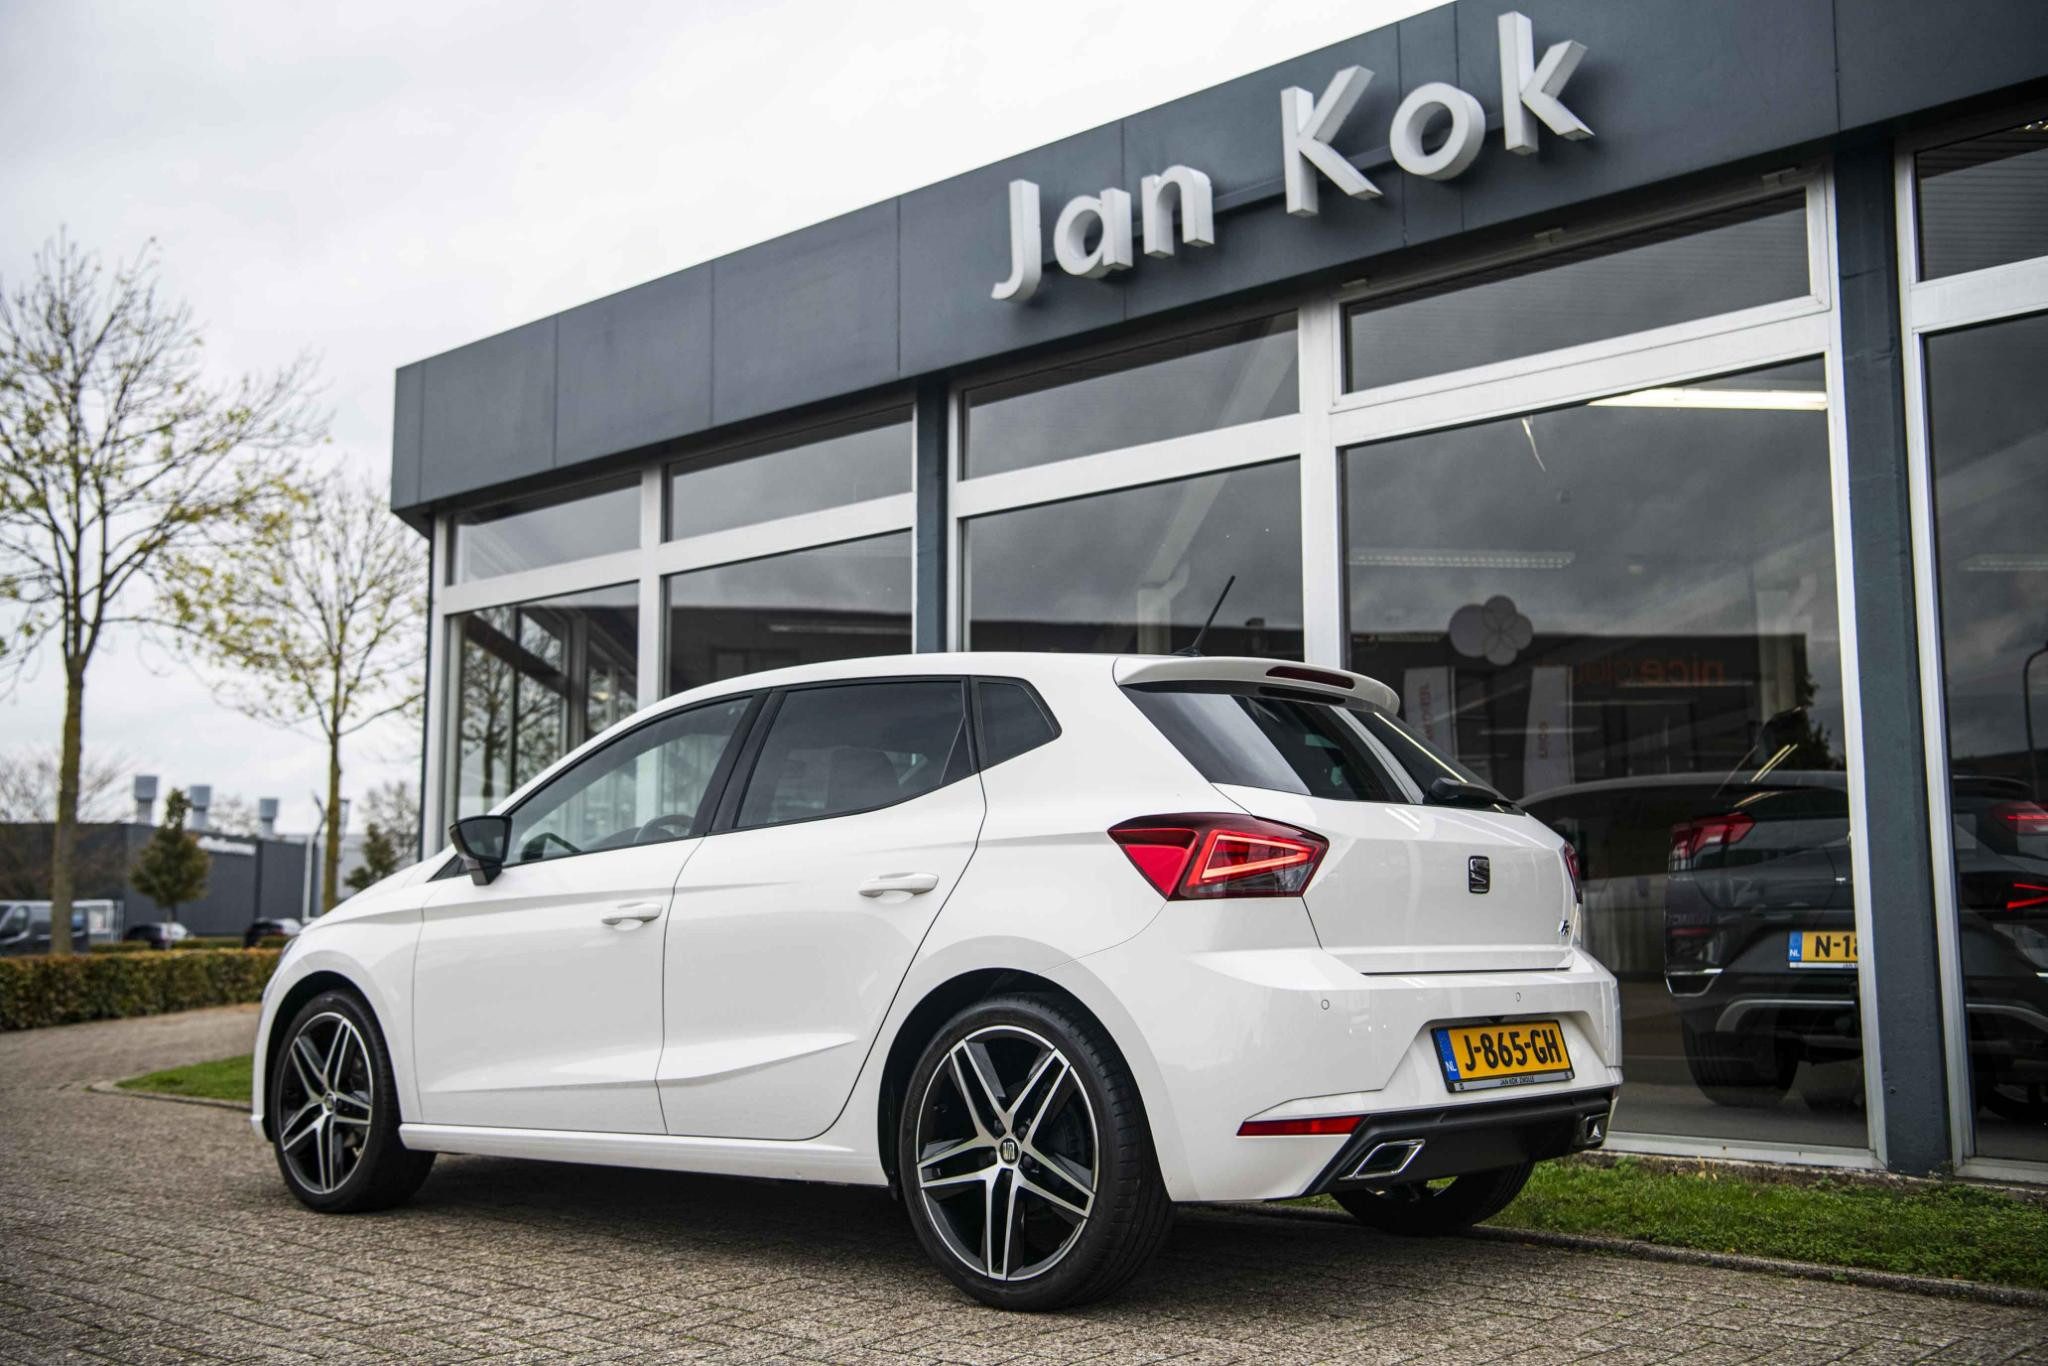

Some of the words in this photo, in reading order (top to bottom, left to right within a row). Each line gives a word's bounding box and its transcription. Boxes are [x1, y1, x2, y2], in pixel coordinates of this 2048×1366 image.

[991, 165, 1215, 300] Jan
[1280, 10, 1595, 217] Kok
[1789, 949, 1800, 957] NL
[1815, 935, 1858, 958] N-1
[1463, 1029, 1562, 1071] J-865-GH
[1445, 1061, 1457, 1072] NL
